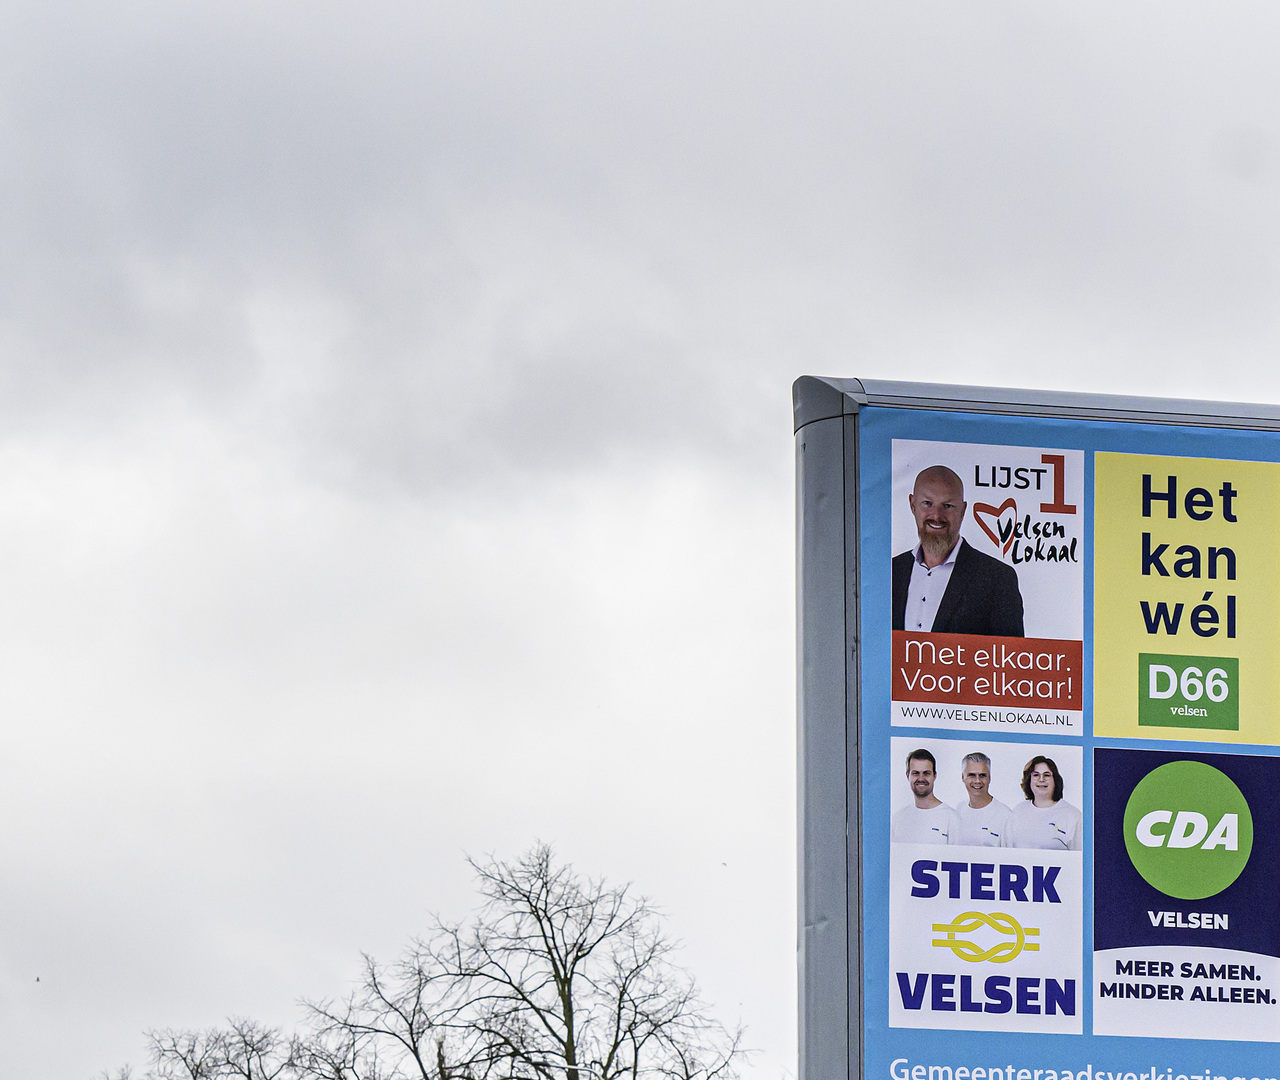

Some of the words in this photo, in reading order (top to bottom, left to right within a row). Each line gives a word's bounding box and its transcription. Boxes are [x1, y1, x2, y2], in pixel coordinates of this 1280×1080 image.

[974, 464, 1048, 491] LIJST
[1039, 453, 1077, 515] 1
[1140, 473, 1238, 523] Het
[996, 514, 1066, 546] Velsen
[1011, 537, 1079, 565] Lokaal
[1140, 532, 1237, 581] kan
[1139, 590, 1237, 639] wél
[904, 639, 966, 667] Met
[973, 643, 1072, 673] elkaar.
[900, 667, 966, 694] Voor
[973, 670, 1073, 699] elkaar!
[1148, 664, 1230, 704] D66
[900, 706, 1073, 727] WWW.VELSENLOKAAL.NL
[1169, 704, 1208, 718] velsen
[1135, 810, 1239, 852] CDA
[910, 859, 1062, 904] STERK
[1147, 911, 1229, 931] VELSEN
[1115, 959, 1175, 978] MEER
[1180, 962, 1262, 982] SAMEN.
[896, 972, 1076, 1017] VELSEN
[1099, 982, 1185, 1001] MINDER
[1189, 985, 1277, 1005] ALLEEN.
